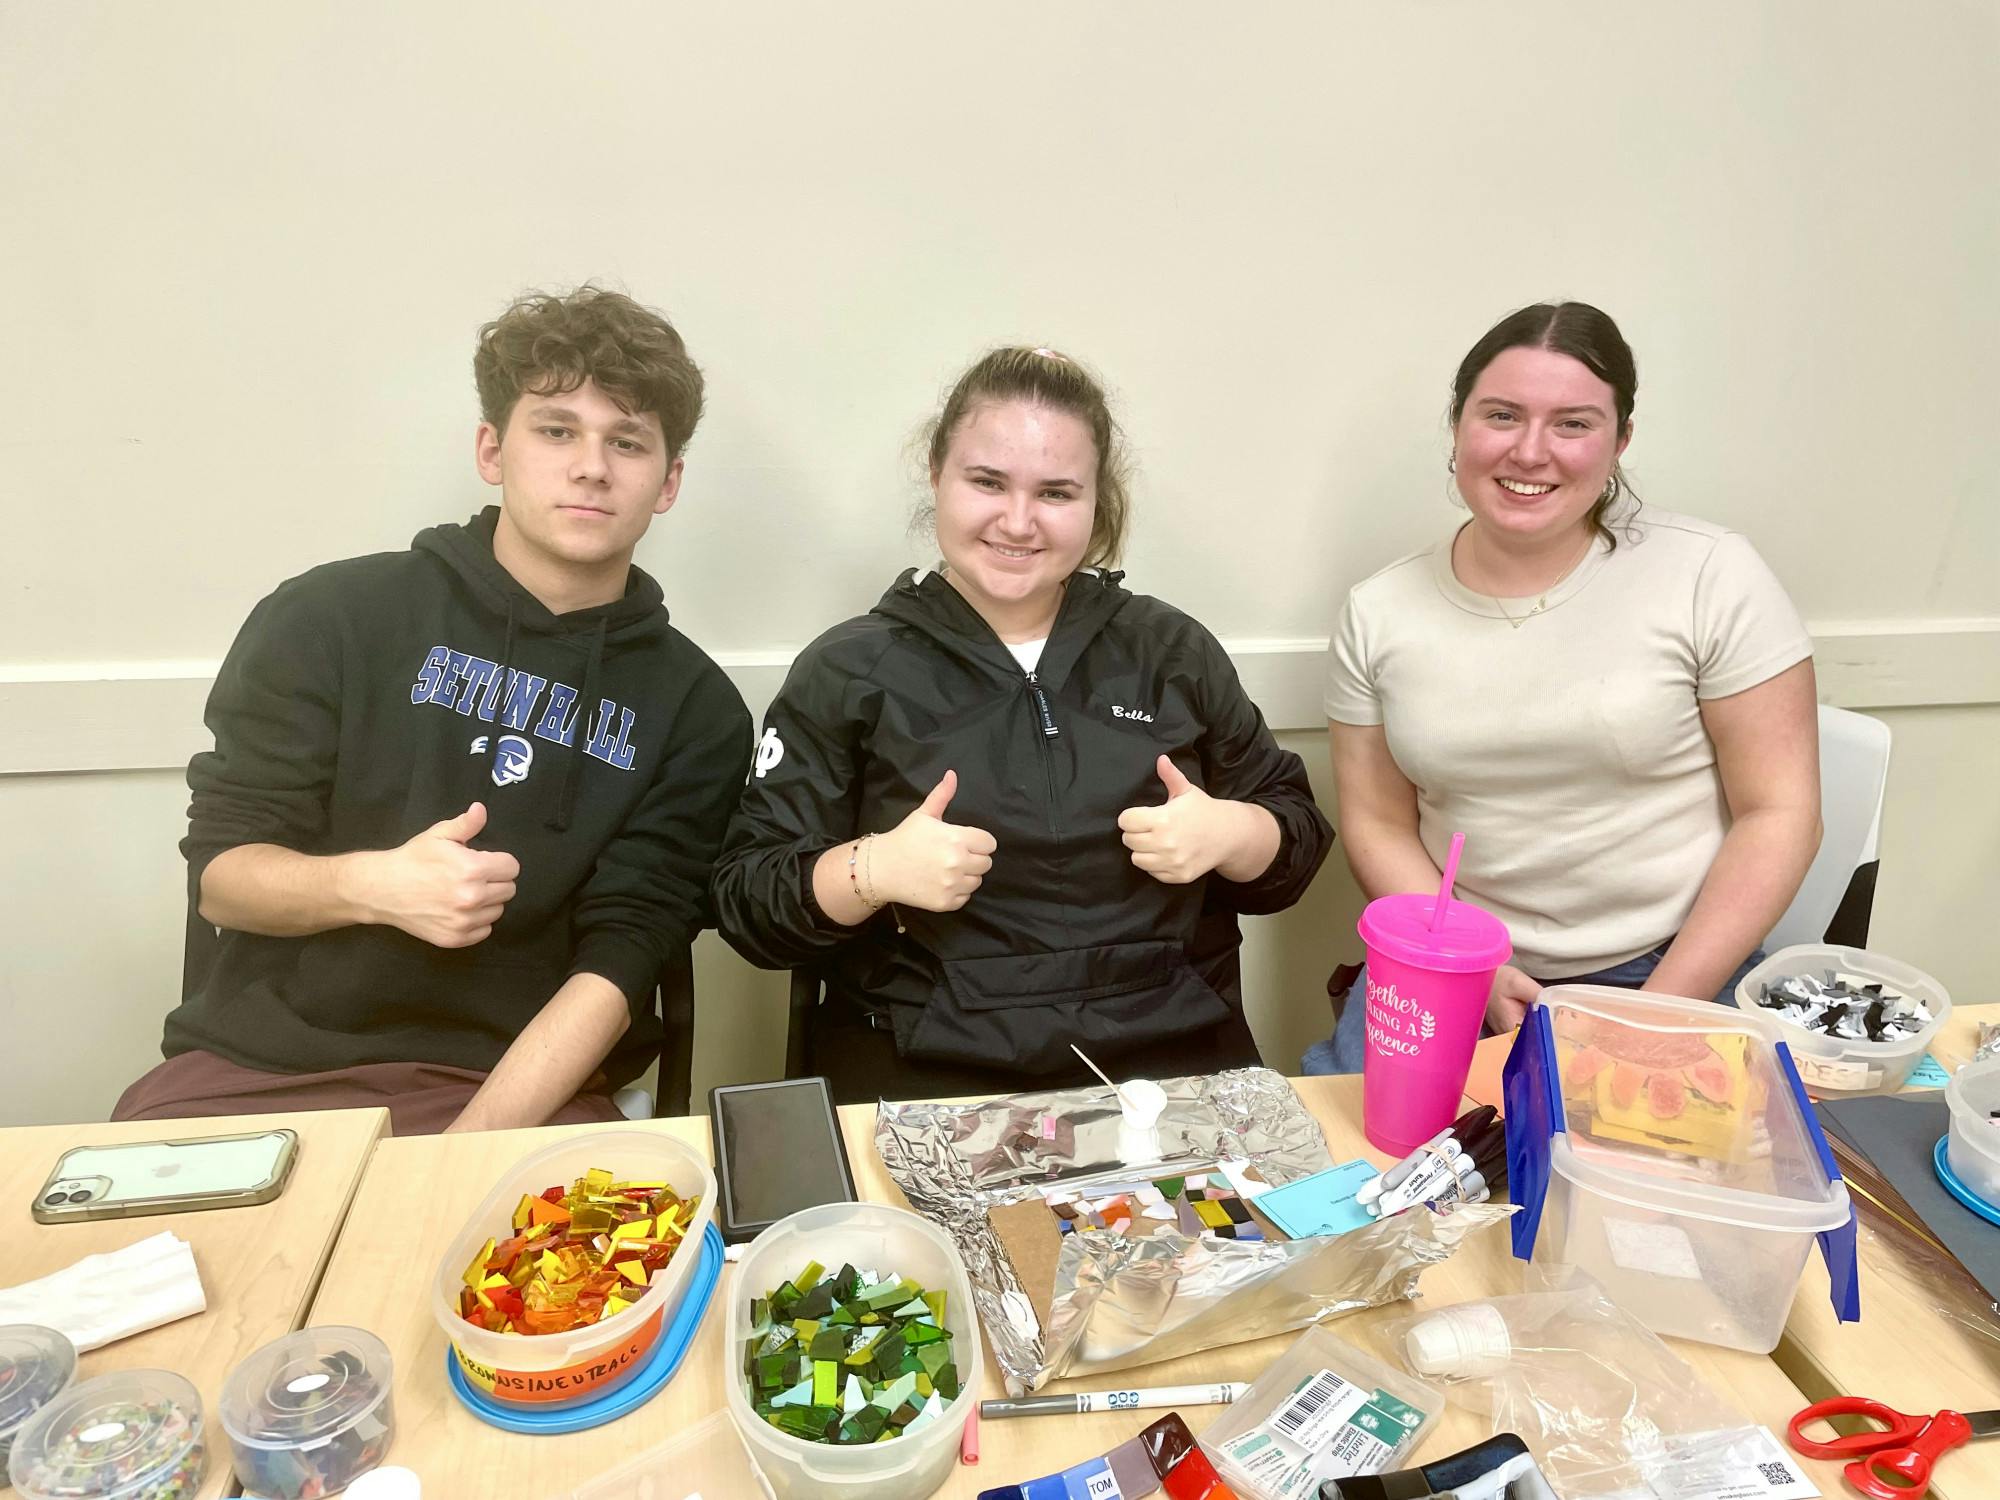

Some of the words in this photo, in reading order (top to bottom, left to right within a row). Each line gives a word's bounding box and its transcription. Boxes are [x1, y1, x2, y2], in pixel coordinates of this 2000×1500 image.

[411, 646, 548, 731] SETON
[1111, 705, 1154, 723] Bella
[1367, 976, 1422, 1018] gether
[1367, 1000, 1400, 1032] AKING
[1405, 1022, 1418, 1037] A
[1367, 1019, 1421, 1056] fference
[1089, 1477, 1113, 1495] TOM
